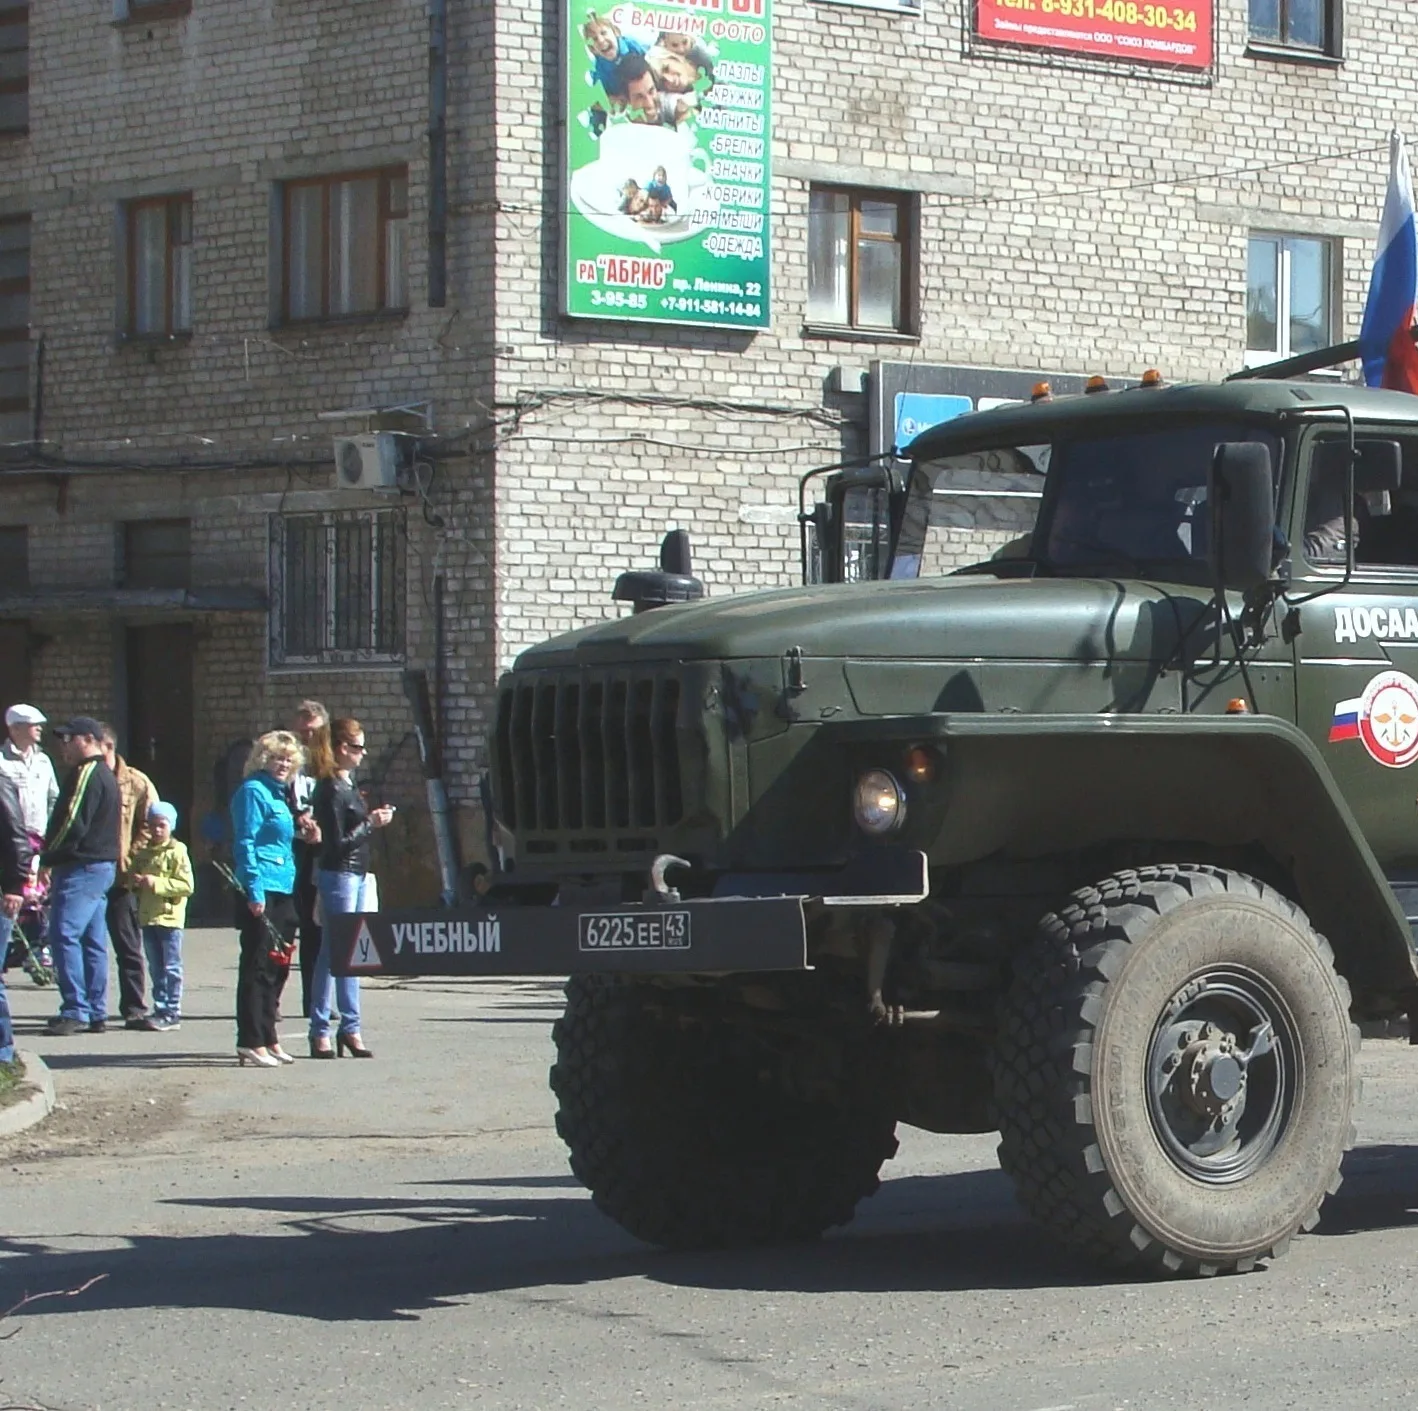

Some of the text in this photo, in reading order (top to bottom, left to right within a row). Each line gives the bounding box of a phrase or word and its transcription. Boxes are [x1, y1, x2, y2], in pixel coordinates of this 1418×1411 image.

[613, 8, 764, 42] С ВАШИМ ФОТО
[1042, 0, 1197, 32] 8-931-408-30-34
[1094, 32, 1113, 43] ООО
[691, 209, 762, 229] ДЛЯ МЫШИ
[579, 258, 672, 287] РА "АБРИС"
[694, 277, 744, 297] Ленина,
[746, 282, 762, 297] 22
[359, 913, 501, 962] У УЧЕБНЫЙ
[666, 914, 685, 937] 43
